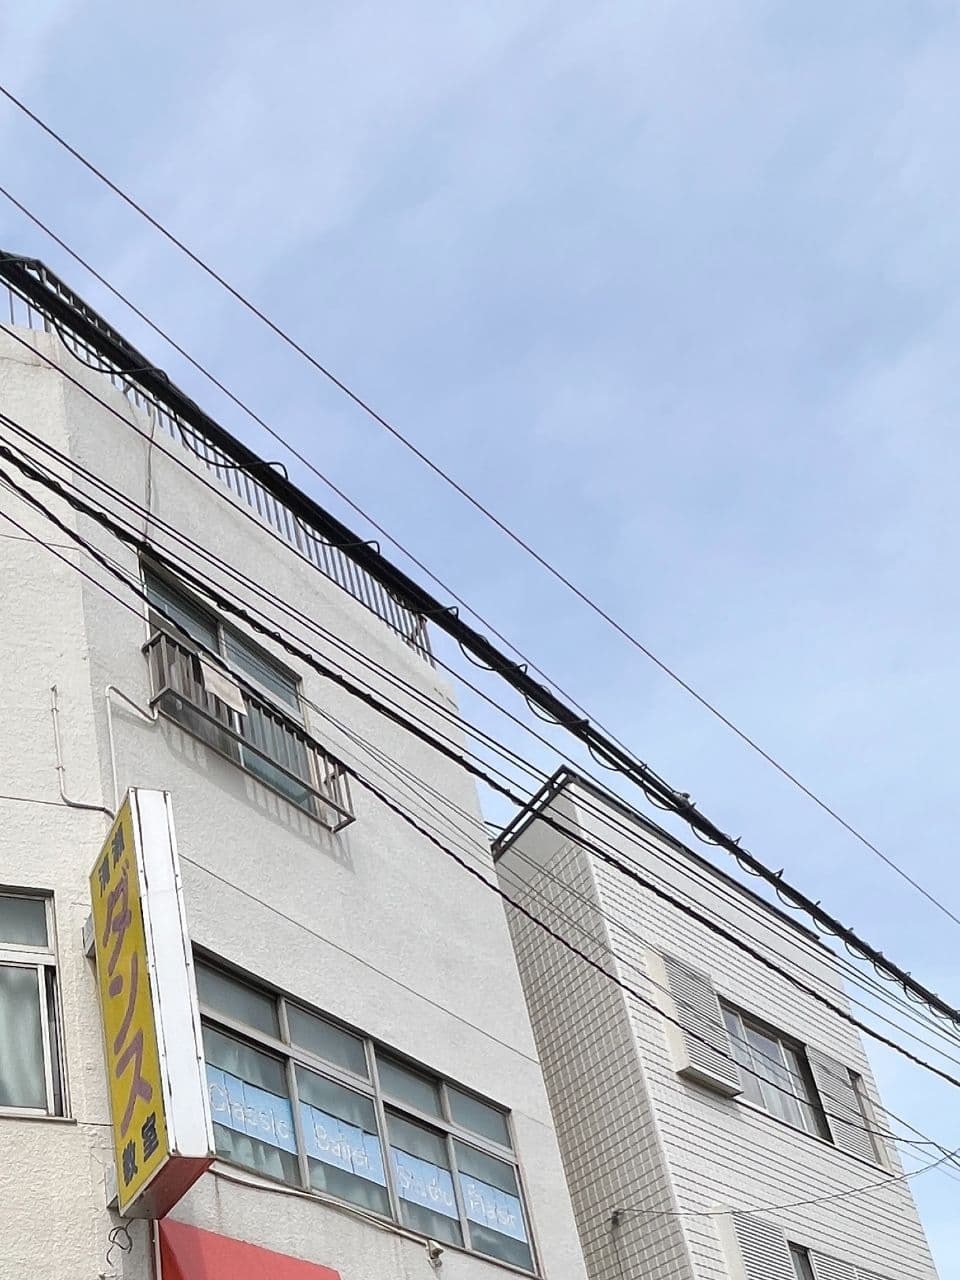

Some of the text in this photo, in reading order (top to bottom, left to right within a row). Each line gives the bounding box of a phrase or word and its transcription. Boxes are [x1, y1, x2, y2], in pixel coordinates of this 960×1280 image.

[103, 859, 153, 1139] ダンス
[122, 1111, 159, 1187] 教室
[208, 1083, 289, 1139] Classic
